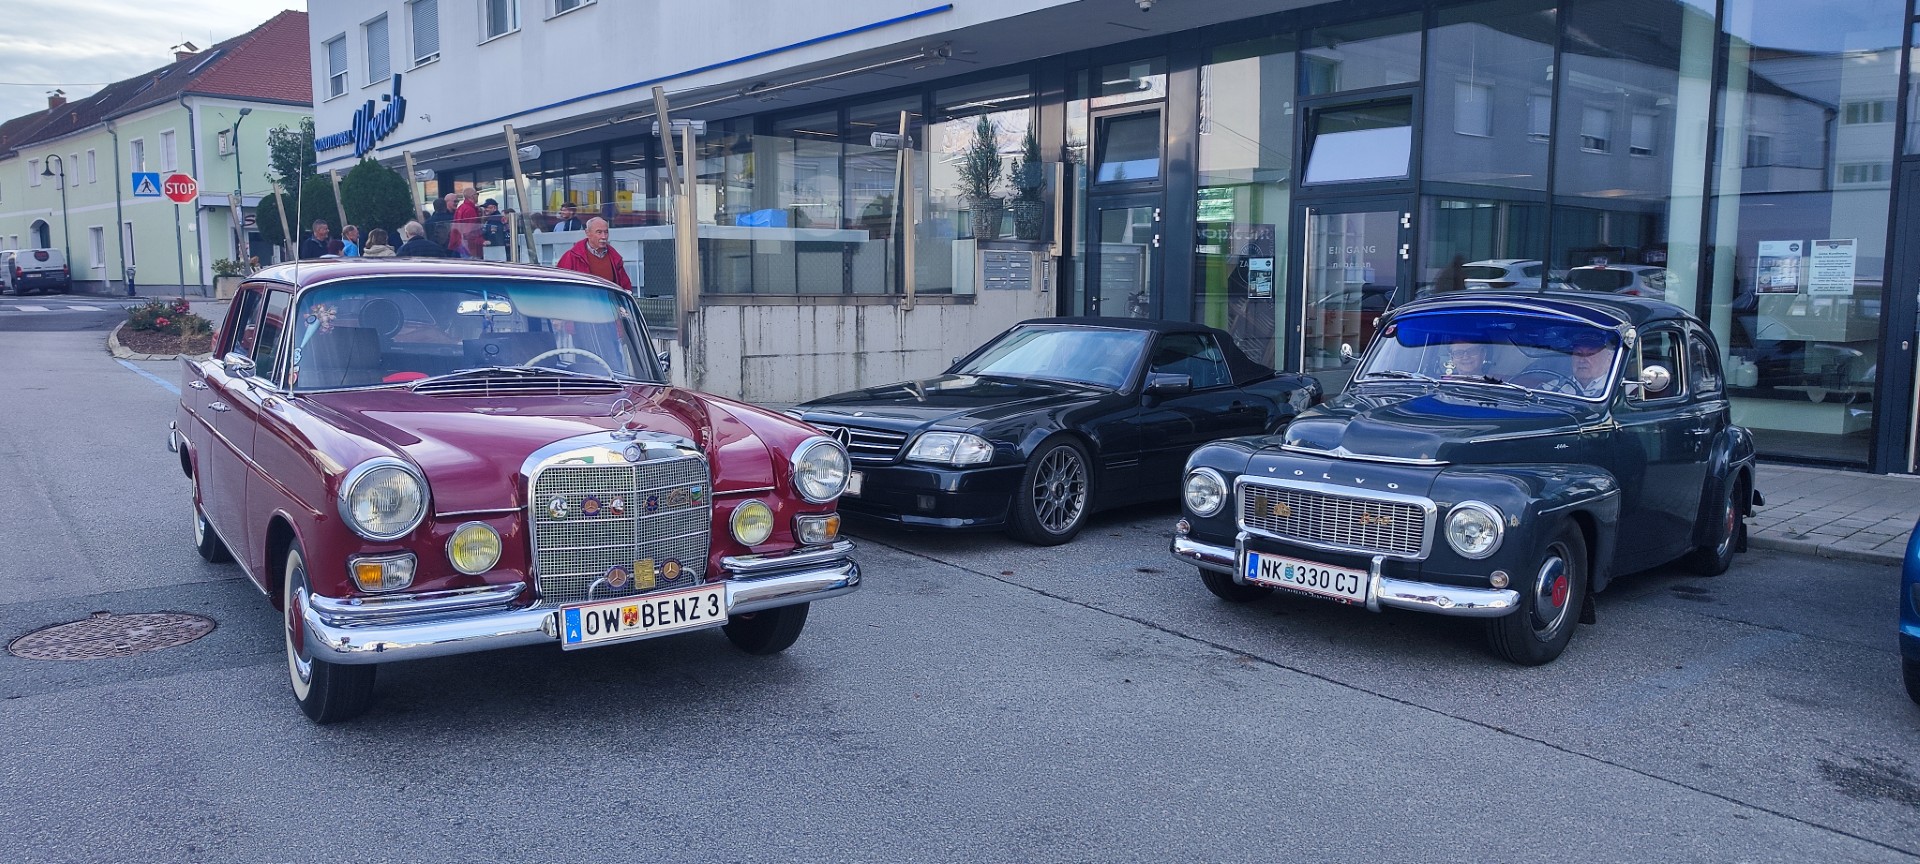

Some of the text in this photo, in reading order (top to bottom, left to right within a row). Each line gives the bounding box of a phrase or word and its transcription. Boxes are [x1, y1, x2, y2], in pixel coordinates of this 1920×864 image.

[165, 182, 196, 195] STOP
[1268, 466, 1399, 488] VOLVO
[1261, 558, 1282, 580] NK
[1296, 565, 1330, 589] 330
[1335, 572, 1359, 595] CJ
[586, 593, 720, 635] OW BENZ 3
[570, 629, 578, 639] A
